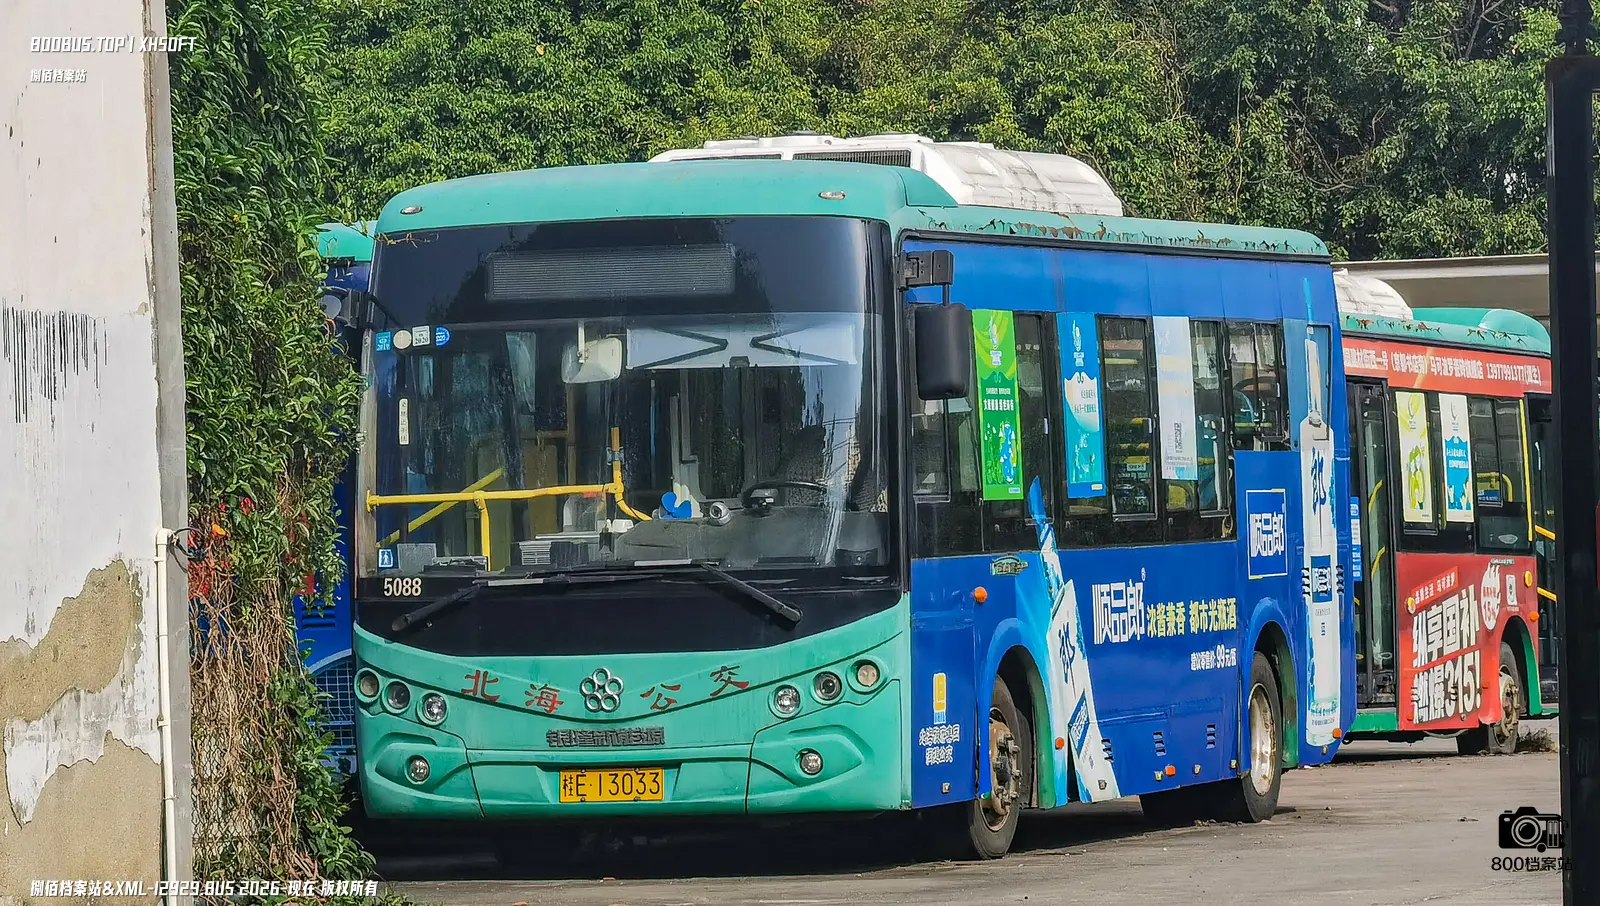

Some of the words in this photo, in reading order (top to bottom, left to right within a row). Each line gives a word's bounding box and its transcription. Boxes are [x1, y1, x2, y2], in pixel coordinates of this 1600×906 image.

[1249, 511, 1284, 557] 顺品郎
[383, 577, 422, 597] 5088
[1092, 578, 1145, 644] 顺品郎
[1147, 601, 1186, 638] 浓酱兼香
[1189, 597, 1237, 634] 都市光瓶酒
[1412, 584, 1480, 668] 纵享国补
[461, 665, 749, 713] 北海公交
